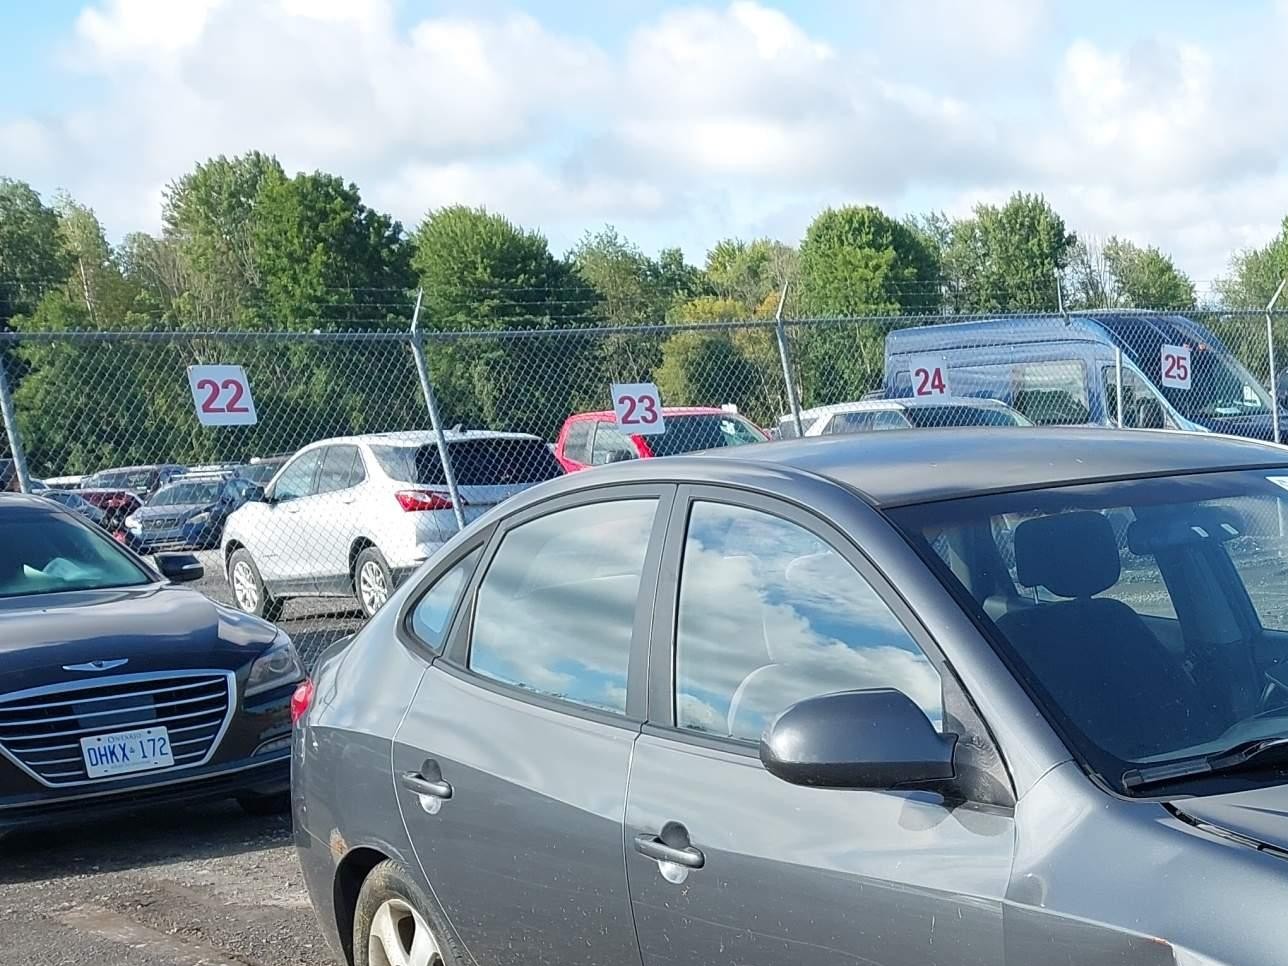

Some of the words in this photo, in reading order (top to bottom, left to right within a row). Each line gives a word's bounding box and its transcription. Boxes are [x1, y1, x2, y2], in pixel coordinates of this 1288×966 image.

[914, 367, 946, 396] 24
[1164, 354, 1188, 380] 25
[197, 379, 249, 413] 22
[618, 395, 658, 424] 23
[87, 742, 130, 767] DHKX
[139, 737, 168, 759] 172
